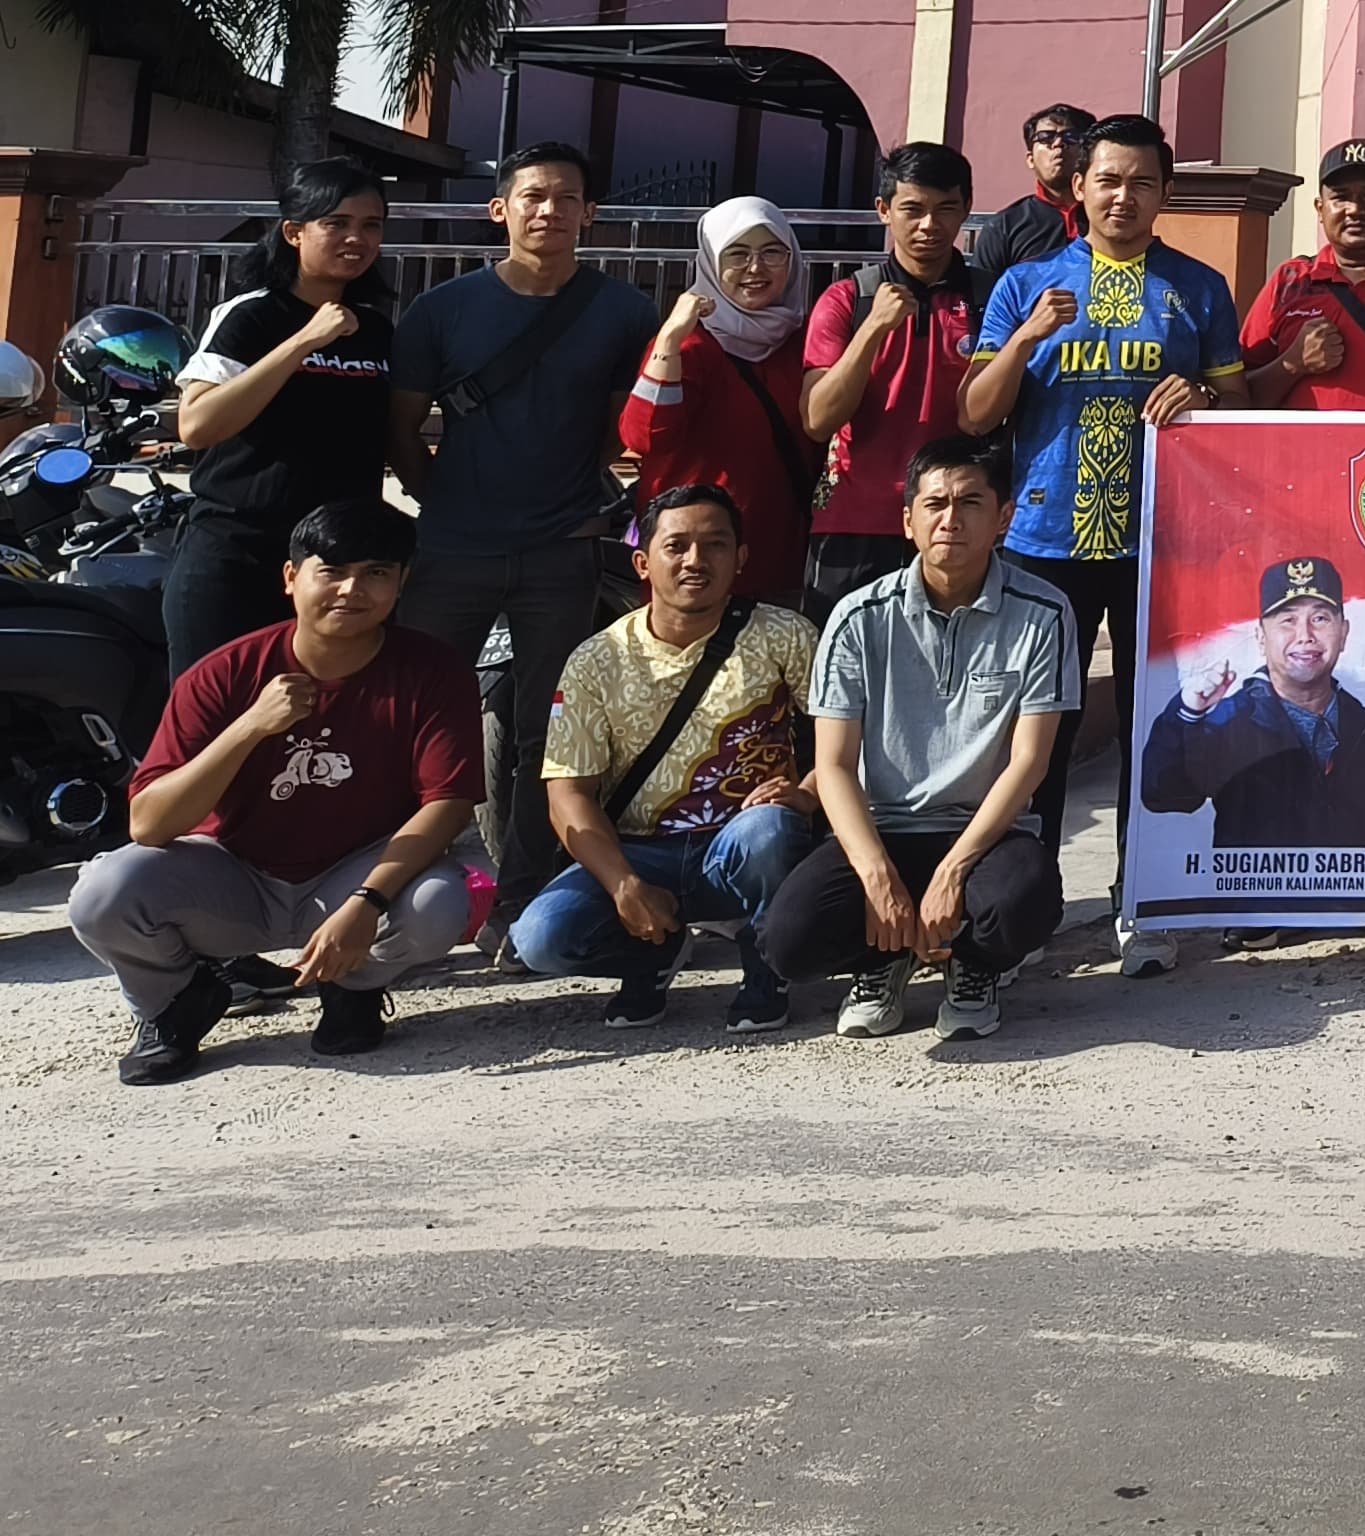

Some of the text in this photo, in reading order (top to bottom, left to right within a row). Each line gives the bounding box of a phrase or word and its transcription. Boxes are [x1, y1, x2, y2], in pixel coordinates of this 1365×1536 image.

[300, 352, 379, 377] didas
[1060, 340, 1162, 372] IKA UB
[1185, 853, 1206, 874] H.
[1212, 853, 1309, 874] SUGIANTO
[1215, 877, 1282, 891] GUBERNUR
[1285, 877, 1364, 891] KALIMANTAN
